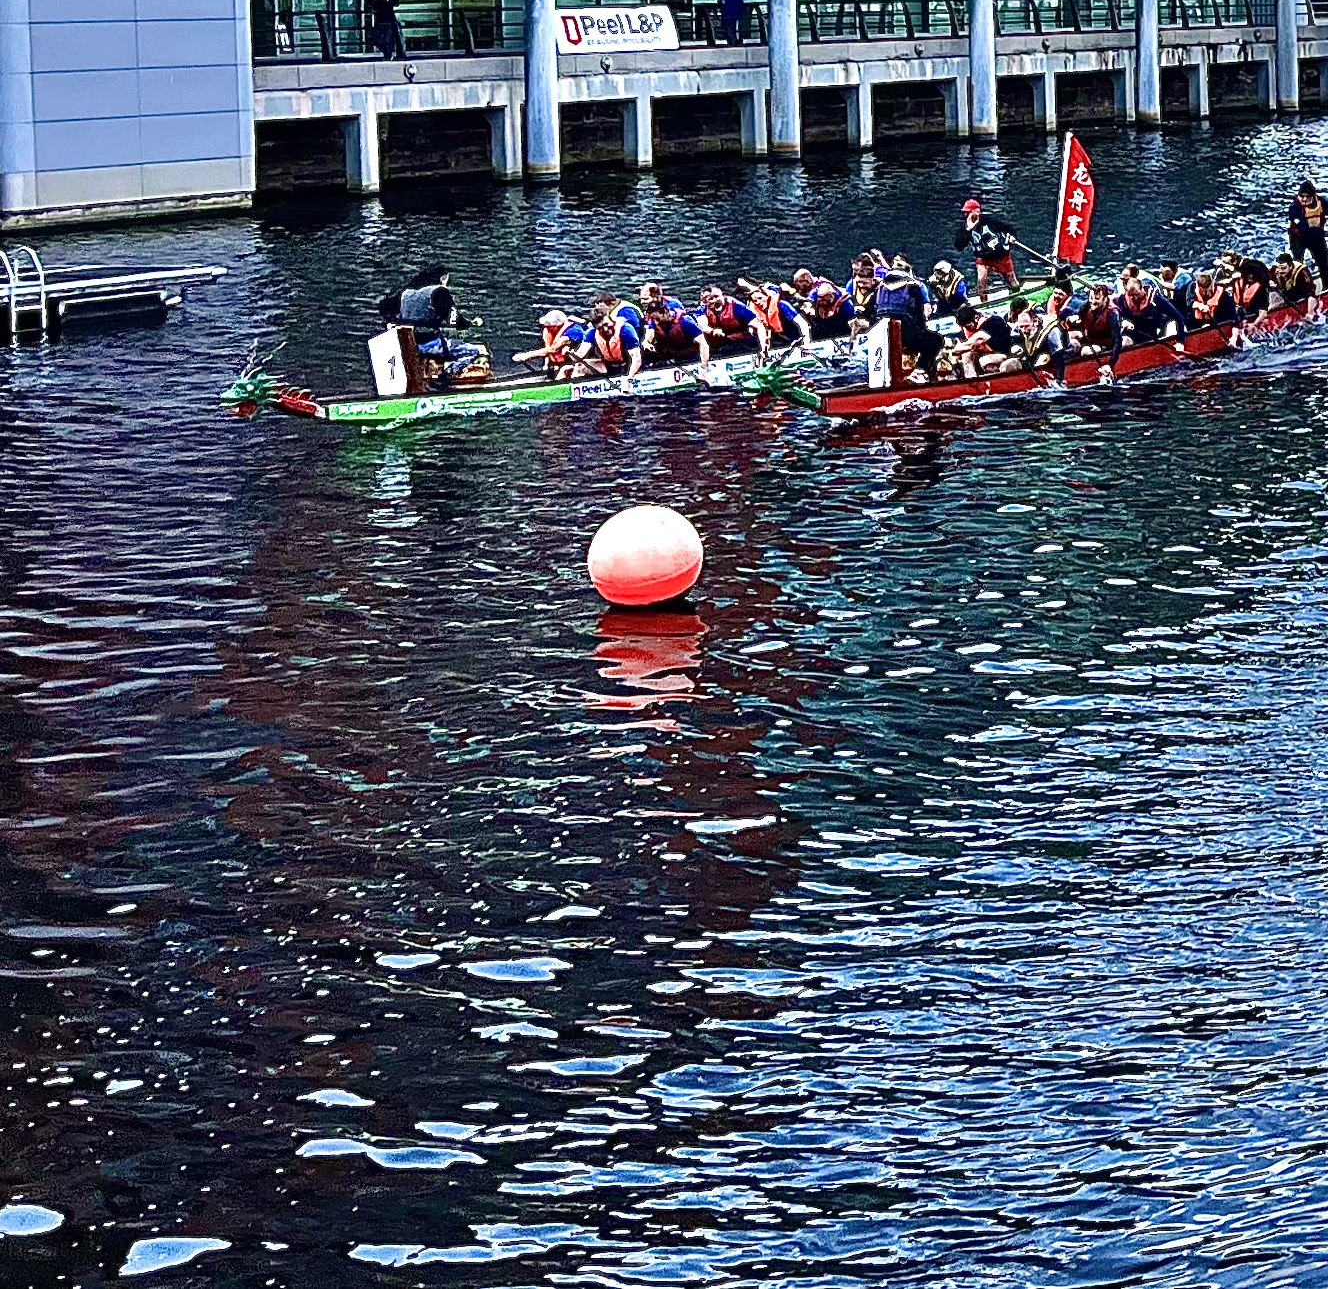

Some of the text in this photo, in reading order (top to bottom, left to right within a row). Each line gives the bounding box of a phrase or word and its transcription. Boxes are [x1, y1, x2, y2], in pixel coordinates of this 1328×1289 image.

[579, 12, 664, 36] Peel L&P
[387, 355, 396, 381] 1
[873, 346, 883, 372] 2
